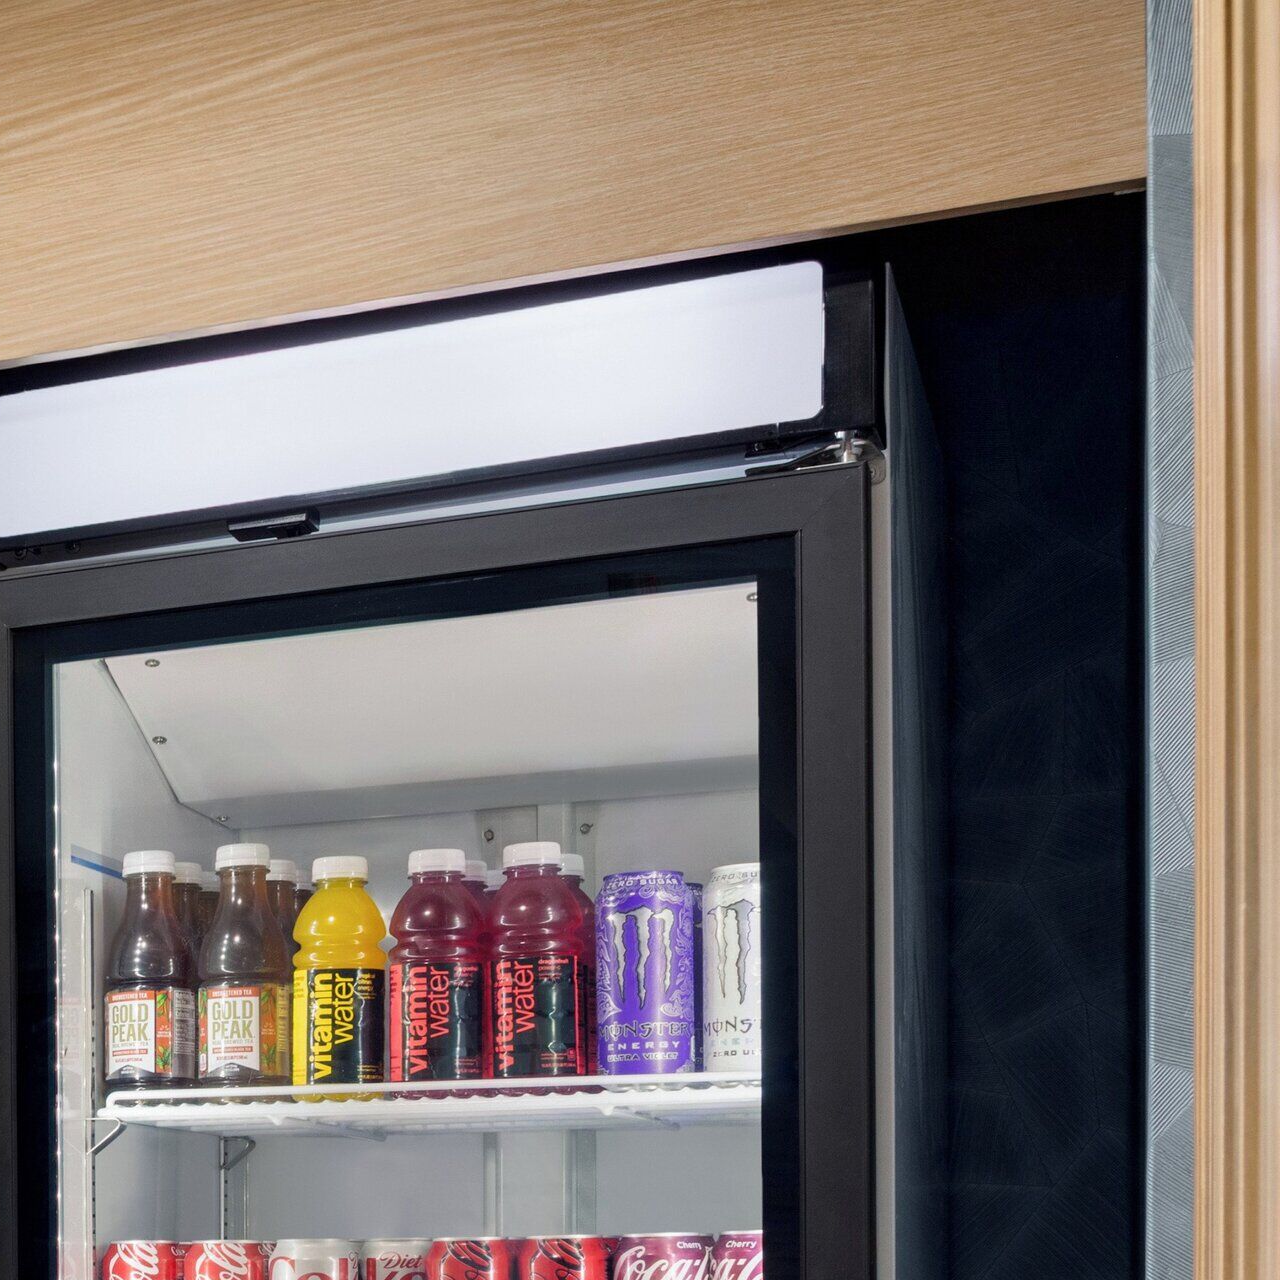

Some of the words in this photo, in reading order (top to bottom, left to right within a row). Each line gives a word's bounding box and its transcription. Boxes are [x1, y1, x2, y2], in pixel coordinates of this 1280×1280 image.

[607, 878, 632, 889] ZERO
[640, 877, 679, 886] SUGAR
[711, 873, 737, 882] ZERO
[430, 966, 449, 1039] water
[513, 960, 536, 1033] water
[112, 1003, 149, 1023] GOLD
[212, 1001, 253, 1019] GOLD
[334, 973, 354, 1044] water
[494, 961, 514, 1071] vitamin
[308, 972, 333, 1080] vitamin
[408, 964, 428, 1074] vitamin
[112, 1021, 149, 1042] PEAK
[212, 1020, 254, 1039] PEAK
[598, 1021, 689, 1038] MONSTER
[607, 1041, 681, 1050] ENERGY
[726, 1240, 756, 1249] Cherry
[380, 1252, 423, 1270] Diet
